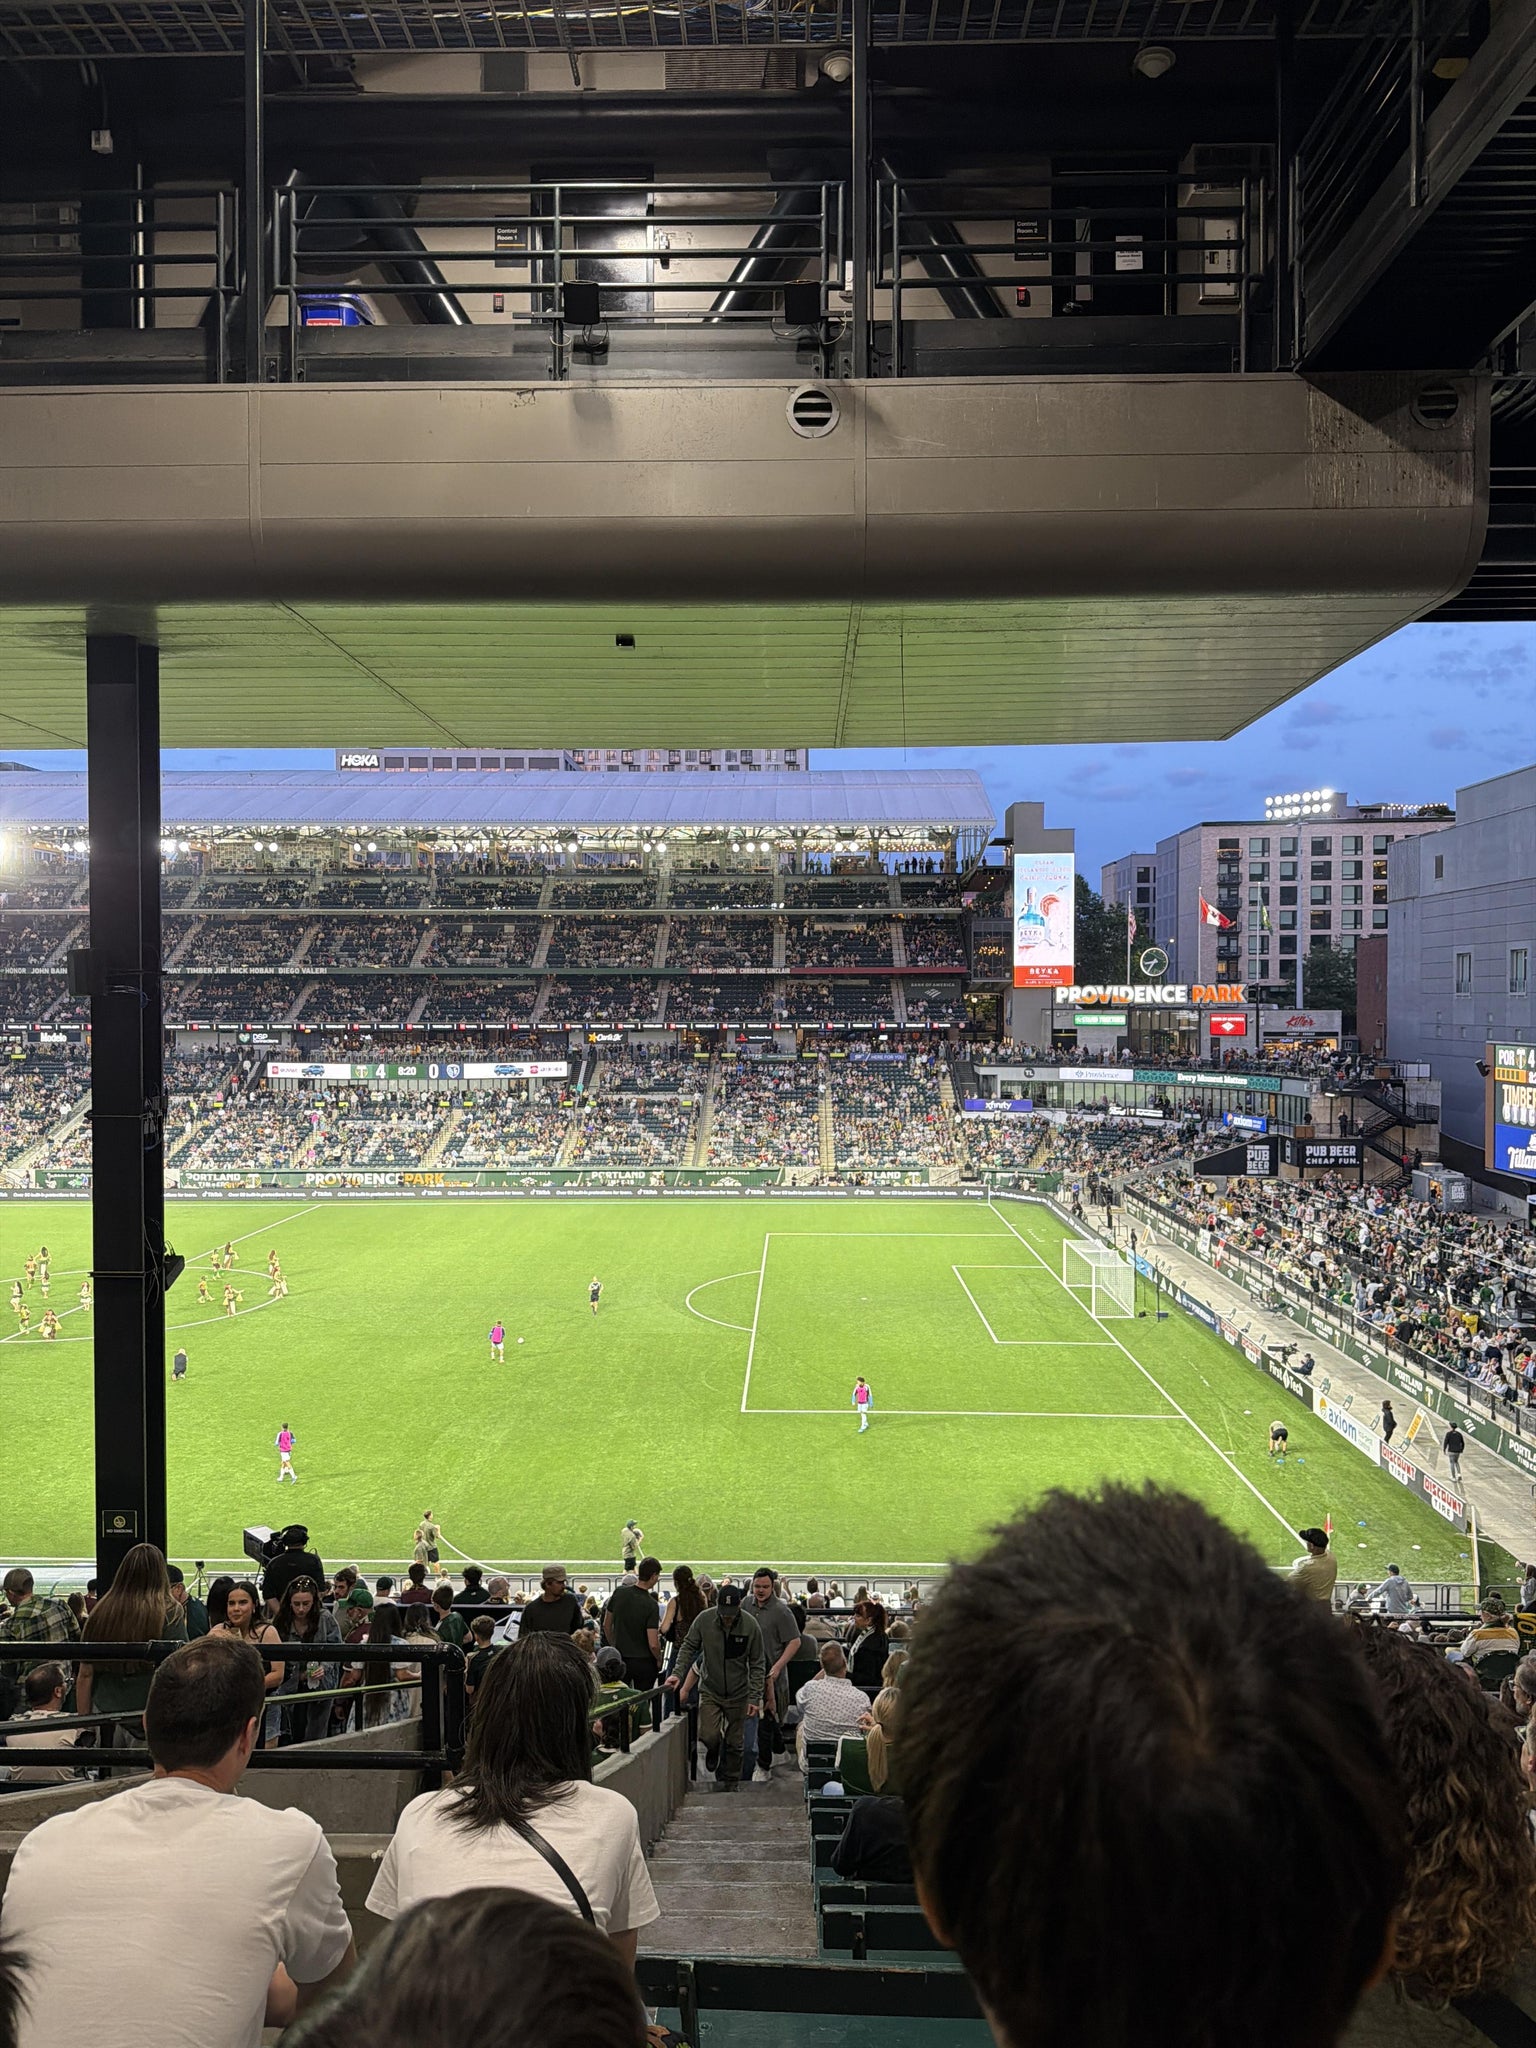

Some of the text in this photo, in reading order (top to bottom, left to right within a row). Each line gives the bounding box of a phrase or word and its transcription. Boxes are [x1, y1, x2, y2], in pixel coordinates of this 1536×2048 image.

[340, 754, 379, 767] HOKA
[1055, 984, 1247, 1004] PROVIDENCE PARK
[40, 1032, 67, 1042] Modelo
[1498, 1049, 1535, 1068] POR 4
[375, 1064, 386, 1078] 4
[428, 1064, 439, 1079] 0
[1084, 1070, 1119, 1079] Providence
[1177, 1073, 1196, 1084] Every
[985, 1102, 1012, 1111] xfinity
[1246, 1150, 1270, 1160] PUB
[1306, 1145, 1356, 1156] PUB BEER
[1246, 1161, 1270, 1170] BEER
[404, 1173, 445, 1184] PARK
[1311, 1317, 1332, 1336] PORTLAND
[1269, 1360, 1303, 1397] First Tech
[1394, 1367, 1422, 1391] PORTLAND
[1328, 1408, 1357, 1442] axiom
[1382, 1444, 1416, 1481] DISCOUNT
[1390, 1463, 1406, 1482] TIRE
[1424, 1475, 1463, 1517] DISCOUNT
[1434, 1498, 1451, 1518] TIRE
